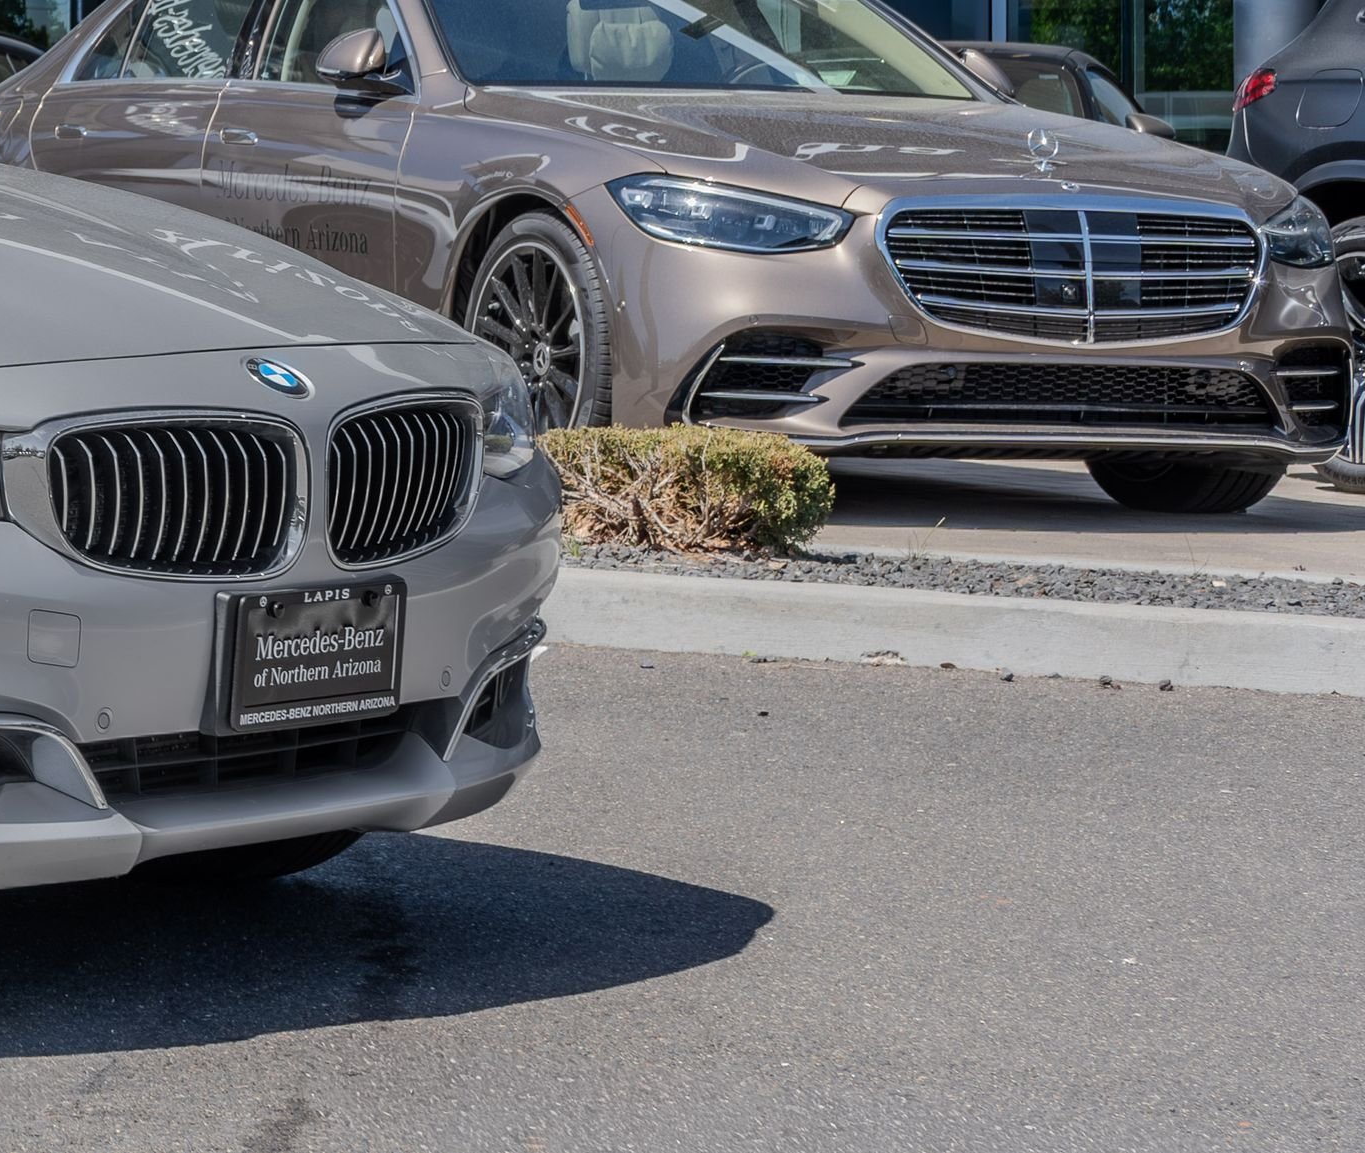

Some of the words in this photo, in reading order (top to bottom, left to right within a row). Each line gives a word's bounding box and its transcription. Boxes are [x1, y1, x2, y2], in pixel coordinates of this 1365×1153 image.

[306, 218, 369, 254] Arizona
[304, 588, 351, 603] LAPIS
[255, 626, 385, 661] Mercedes-Benz
[253, 668, 269, 688] of
[269, 664, 329, 686] Northern
[332, 658, 382, 678] Arizona
[239, 706, 311, 726] MERCEDES-BENZ
[312, 701, 359, 717] NORTHERN
[359, 695, 396, 710] ARIZONA
